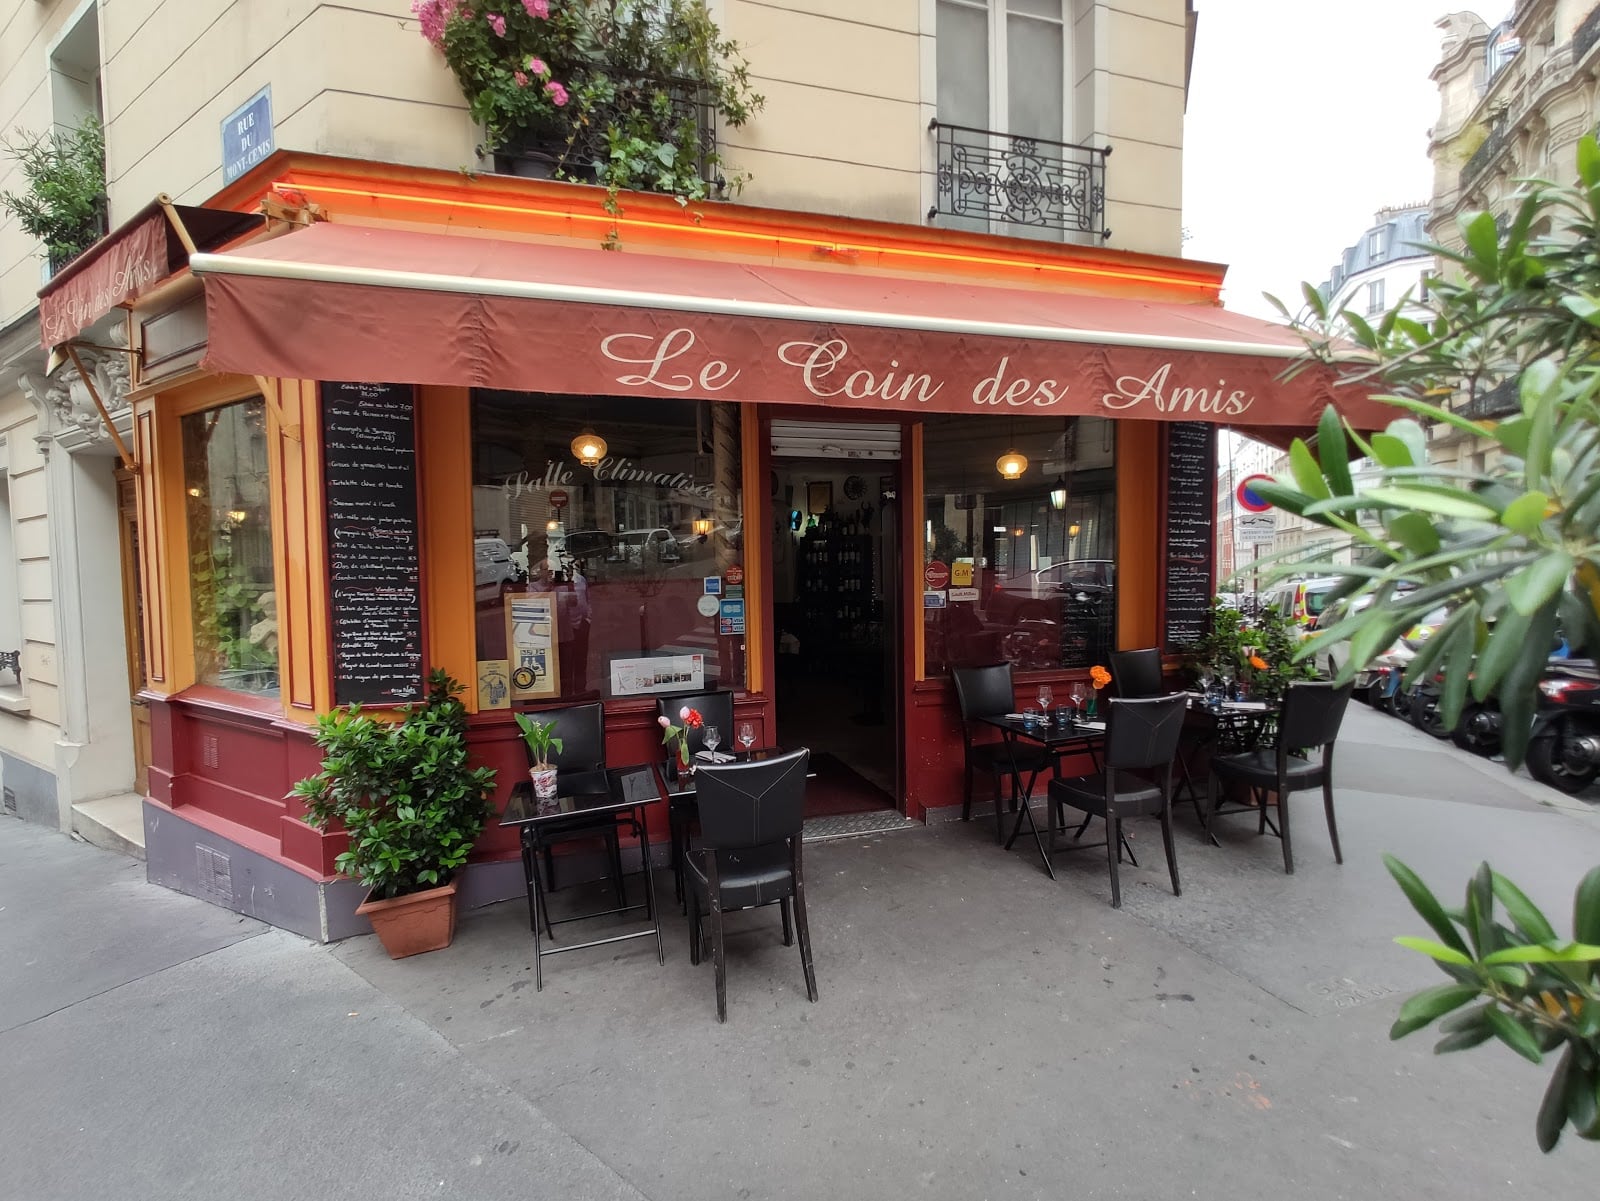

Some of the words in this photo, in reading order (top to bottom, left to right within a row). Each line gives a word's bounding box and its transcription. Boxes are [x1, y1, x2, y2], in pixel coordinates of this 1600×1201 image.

[237, 112, 255, 136] RUE
[241, 133, 253, 152] DU
[227, 138, 271, 179] MONT-CENIS
[600, 328, 741, 391] Le
[778, 339, 944, 402] Coin
[972, 356, 1069, 406] des
[1102, 363, 1255, 414] Amis
[505, 460, 574, 500] Salle
